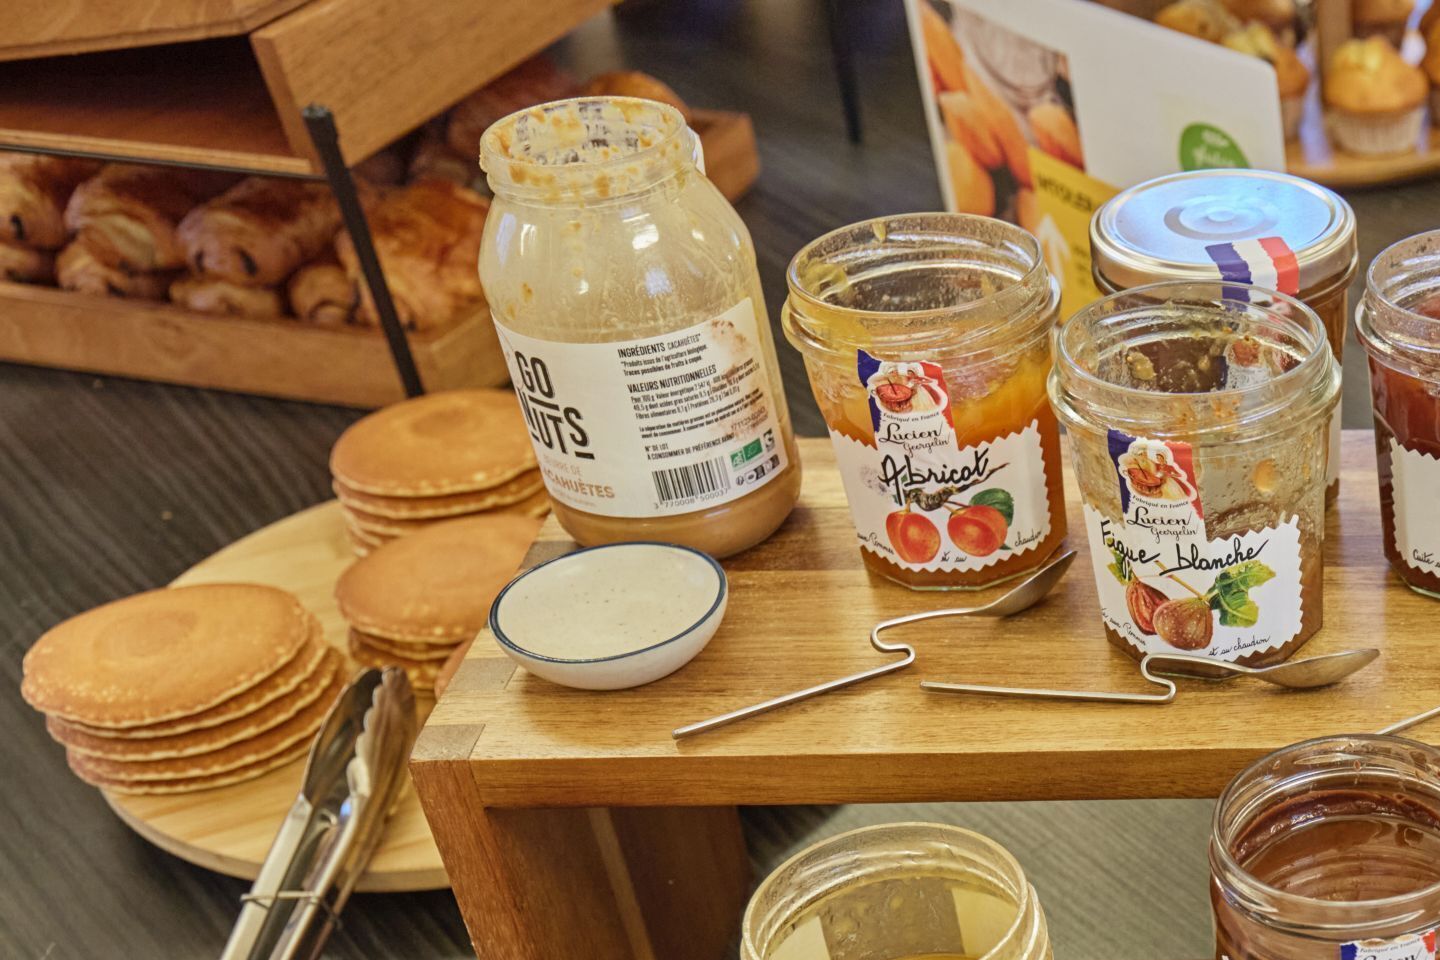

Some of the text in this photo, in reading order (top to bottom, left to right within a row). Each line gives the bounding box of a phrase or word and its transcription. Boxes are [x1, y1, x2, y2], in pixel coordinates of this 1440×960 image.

[617, 341, 666, 358] INGRÉDIENTS
[515, 351, 555, 399] GO
[623, 368, 640, 376] Traces
[640, 364, 665, 376] possibles
[671, 360, 685, 369] fruits
[627, 380, 659, 393] VALEURS
[660, 364, 717, 389] NUTRITIONNELLES
[878, 421, 944, 444] Lucien
[651, 448, 685, 460] CONSOMMER
[686, 446, 691, 455] DE
[692, 439, 721, 453] PRÉFÉRENCE
[903, 439, 950, 458] Georgelin
[878, 448, 989, 506] Abricot
[1126, 506, 1193, 529] Lucien
[1150, 525, 1198, 544] Georgelin
[1100, 519, 1269, 580] Figue blanche
[1412, 548, 1434, 565] Cuite
[1233, 635, 1271, 652] chaudron
